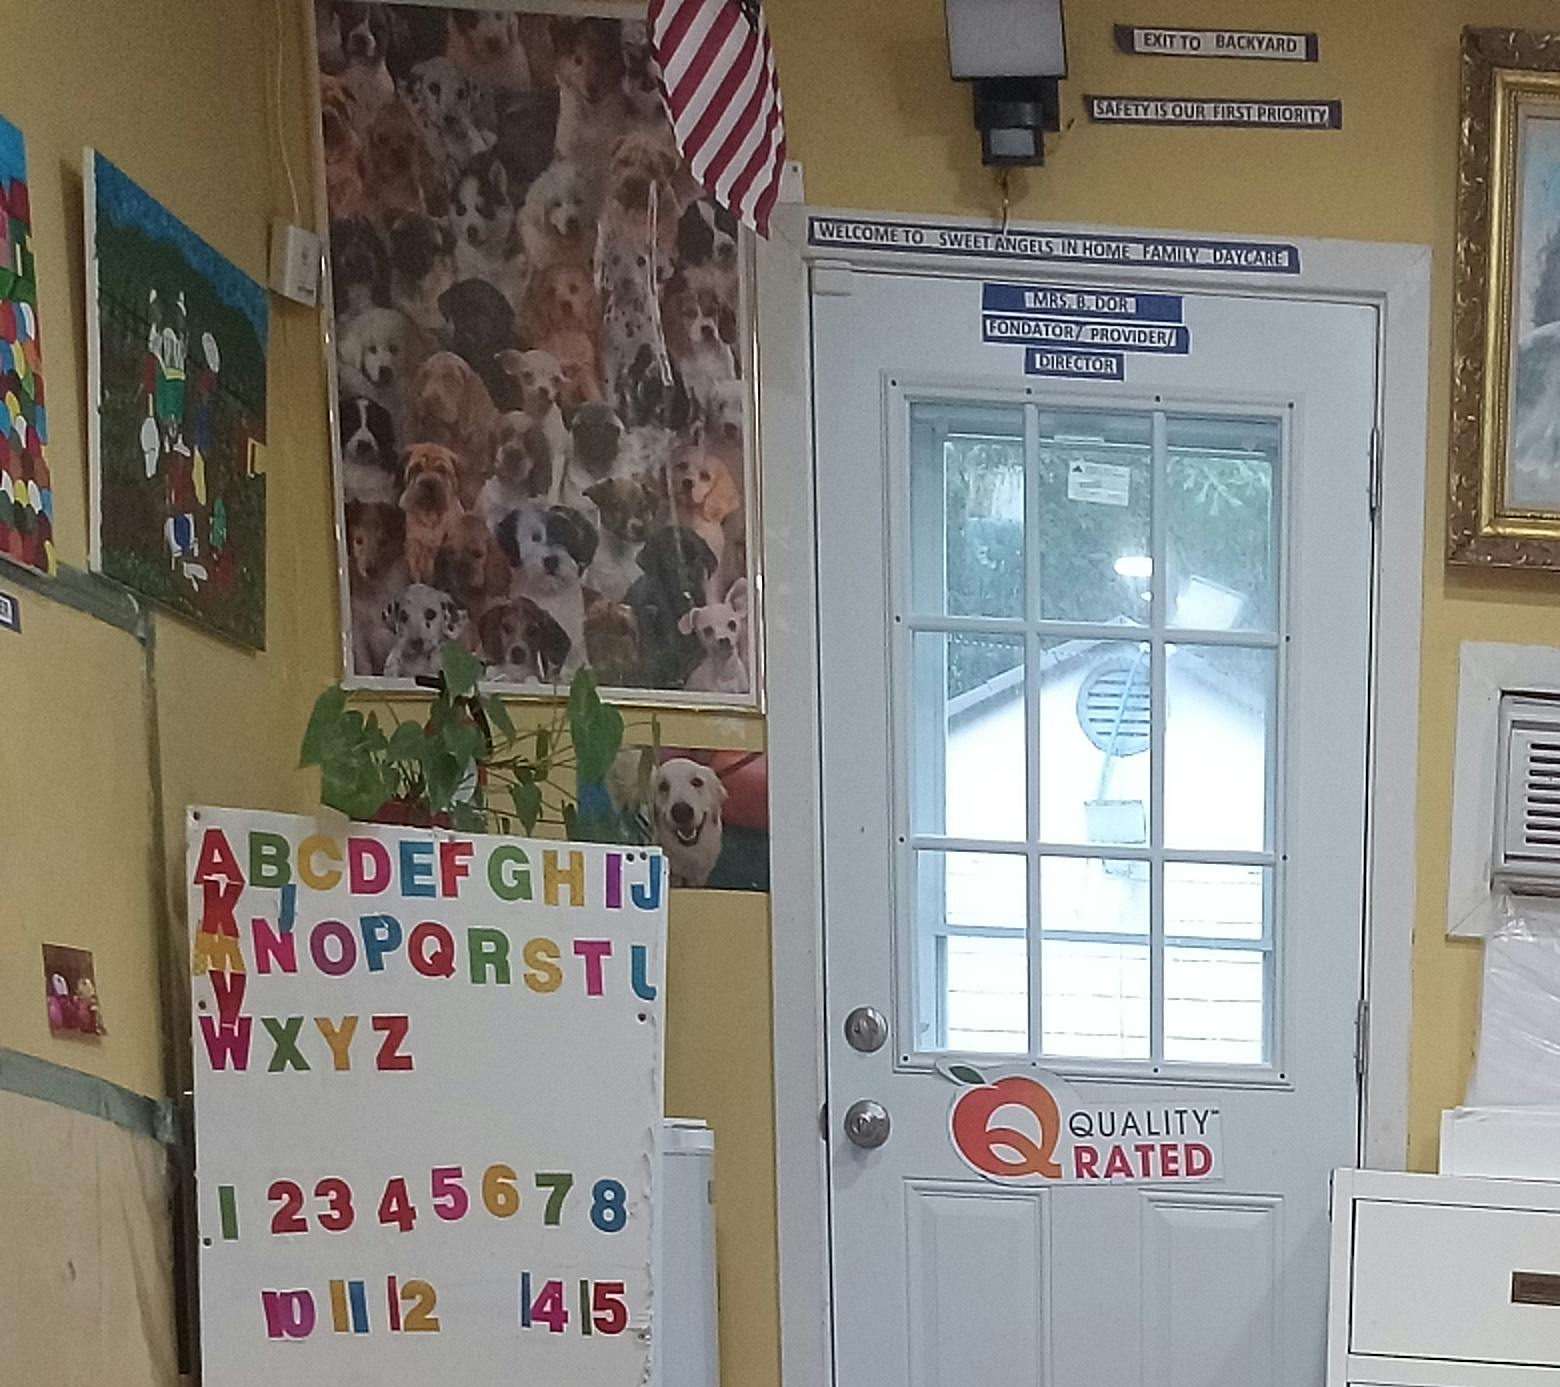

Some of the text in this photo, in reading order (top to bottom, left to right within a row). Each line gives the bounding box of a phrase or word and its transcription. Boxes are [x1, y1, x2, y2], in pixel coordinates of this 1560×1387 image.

[1142, 31, 1298, 53] EXIT TO BACKYARD
[1096, 101, 1327, 124] SAFETY IS OUR FIRST PRIORITY
[819, 222, 1283, 267] WELCOME TO SWEET ANGELS IN HOME FAMILY DAYCARE
[1038, 353, 1115, 373] DIRECTOR
[1073, 1143, 1214, 1179] RATED
[218, 1164, 628, 1240] 1 2 3 4 5 6 7 8
[261, 1290, 316, 1339] 10
[387, 1276, 441, 1333] 12
[520, 1271, 569, 1333] 14
[579, 1279, 628, 1335] 15
